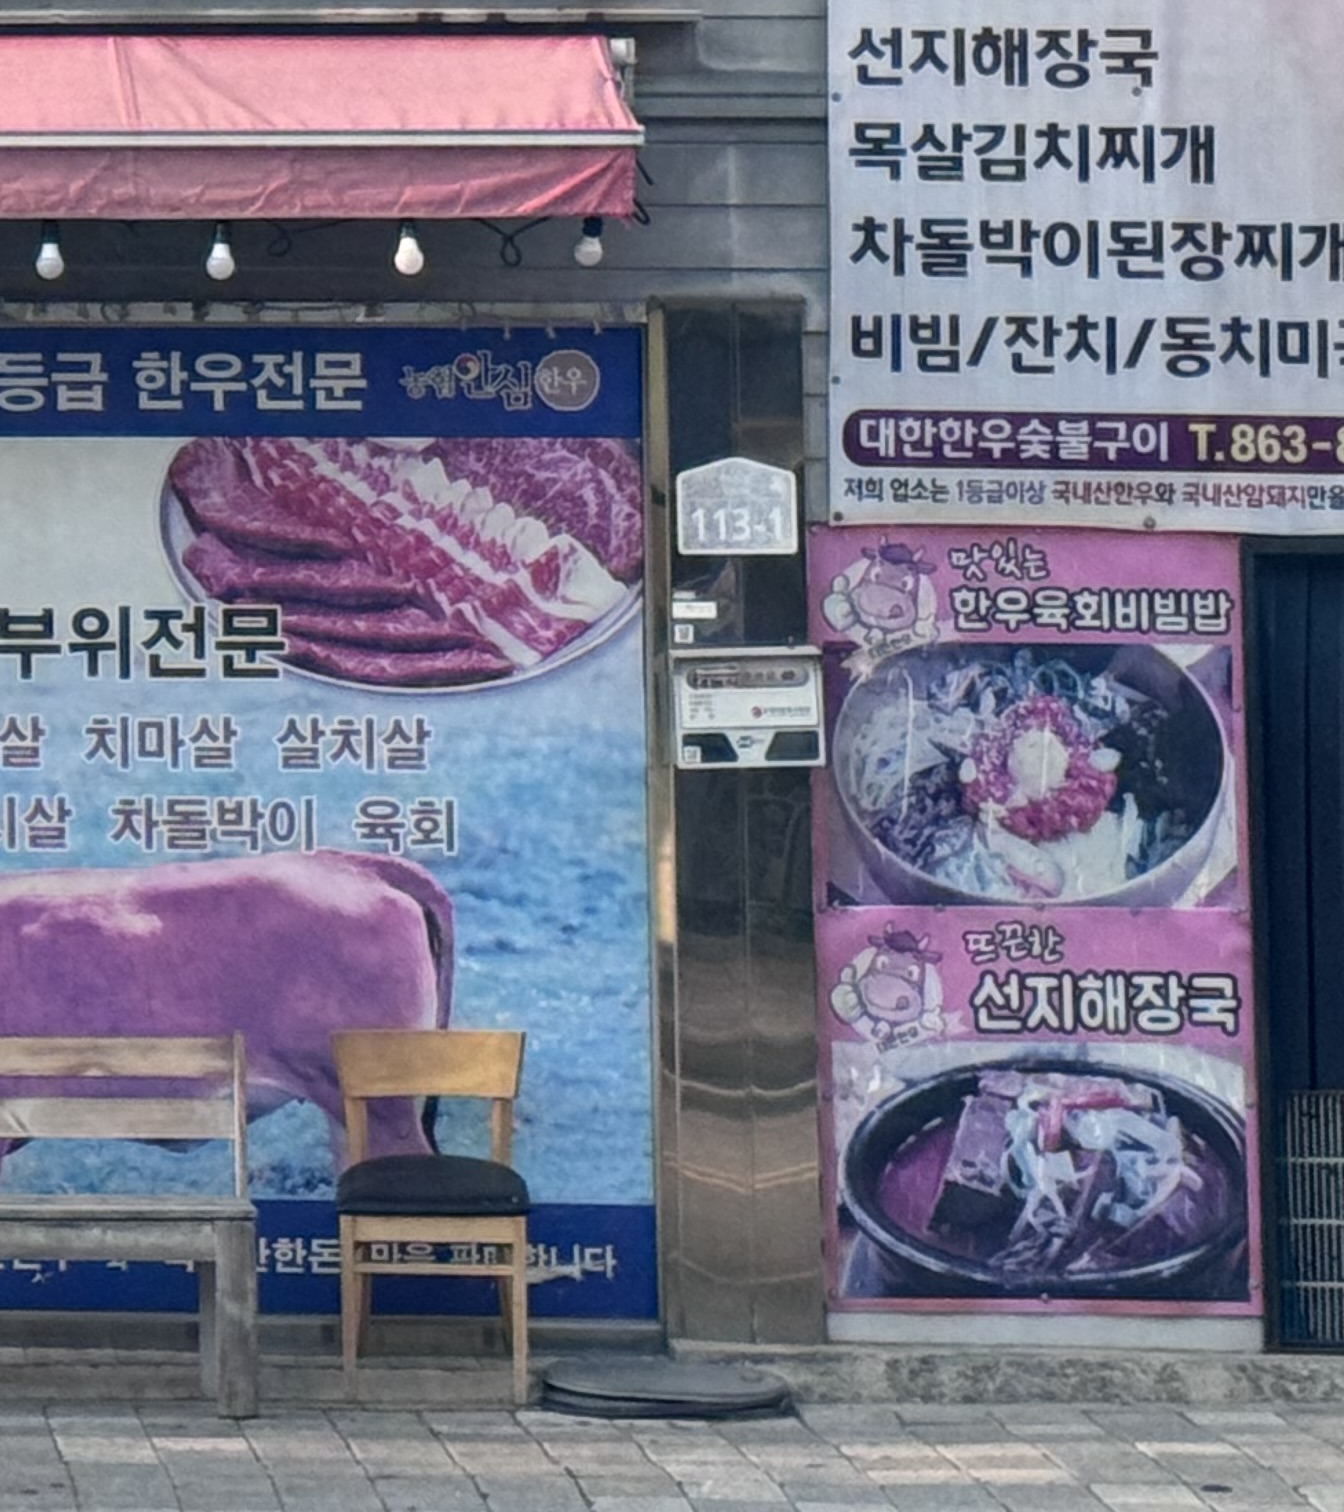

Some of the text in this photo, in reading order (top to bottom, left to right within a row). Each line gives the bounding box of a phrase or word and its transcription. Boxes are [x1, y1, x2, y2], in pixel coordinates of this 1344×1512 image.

[847, 26, 1160, 89] 선지해장국
[847, 121, 1216, 185] 목살김치찌개
[132, 350, 369, 412] 한우전문
[858, 417, 1170, 464] 대한한우숯불구이
[843, 476, 885, 503] 저희
[889, 476, 951, 504] 업소는
[691, 508, 783, 541] 113-1
[948, 538, 1050, 580] 맛있는
[949, 587, 1236, 635] 한우육회비빔밥
[83, 715, 238, 771] 치마살
[275, 715, 432, 772] 살치살
[110, 796, 317, 854] 차돌박이
[354, 797, 459, 856] 육회
[964, 921, 1064, 963] 뜨끈한
[971, 969, 1242, 1036] 선지해장국
